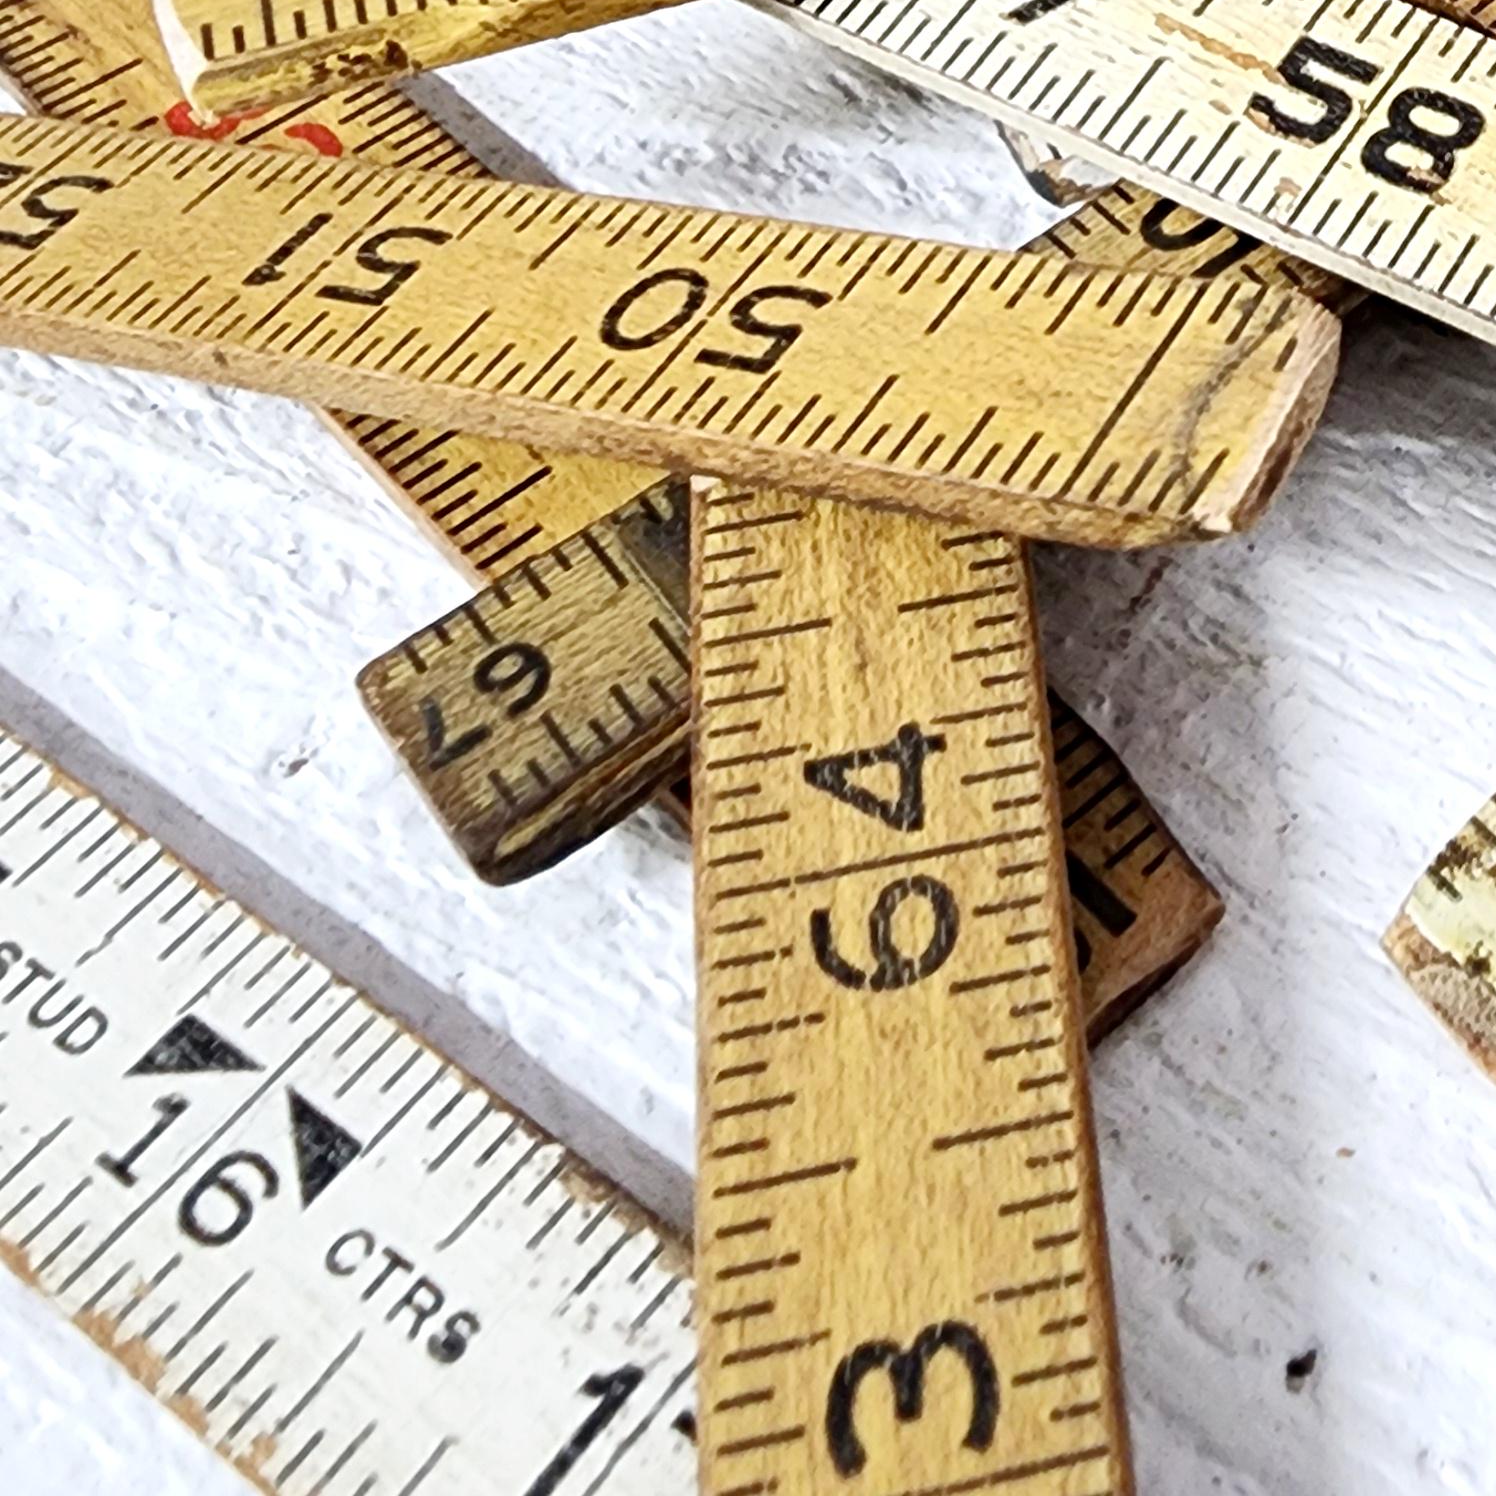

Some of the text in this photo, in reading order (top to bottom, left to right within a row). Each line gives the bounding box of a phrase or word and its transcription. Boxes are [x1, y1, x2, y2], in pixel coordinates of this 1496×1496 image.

[1249, 33, 1487, 196] 58
[242, 212, 454, 307] 51
[598, 267, 833, 374] 50
[418, 640, 552, 772] 67
[801, 720, 959, 994] 64
[96, 1092, 281, 1248] 16
[323, 1228, 481, 1366] CTRS
